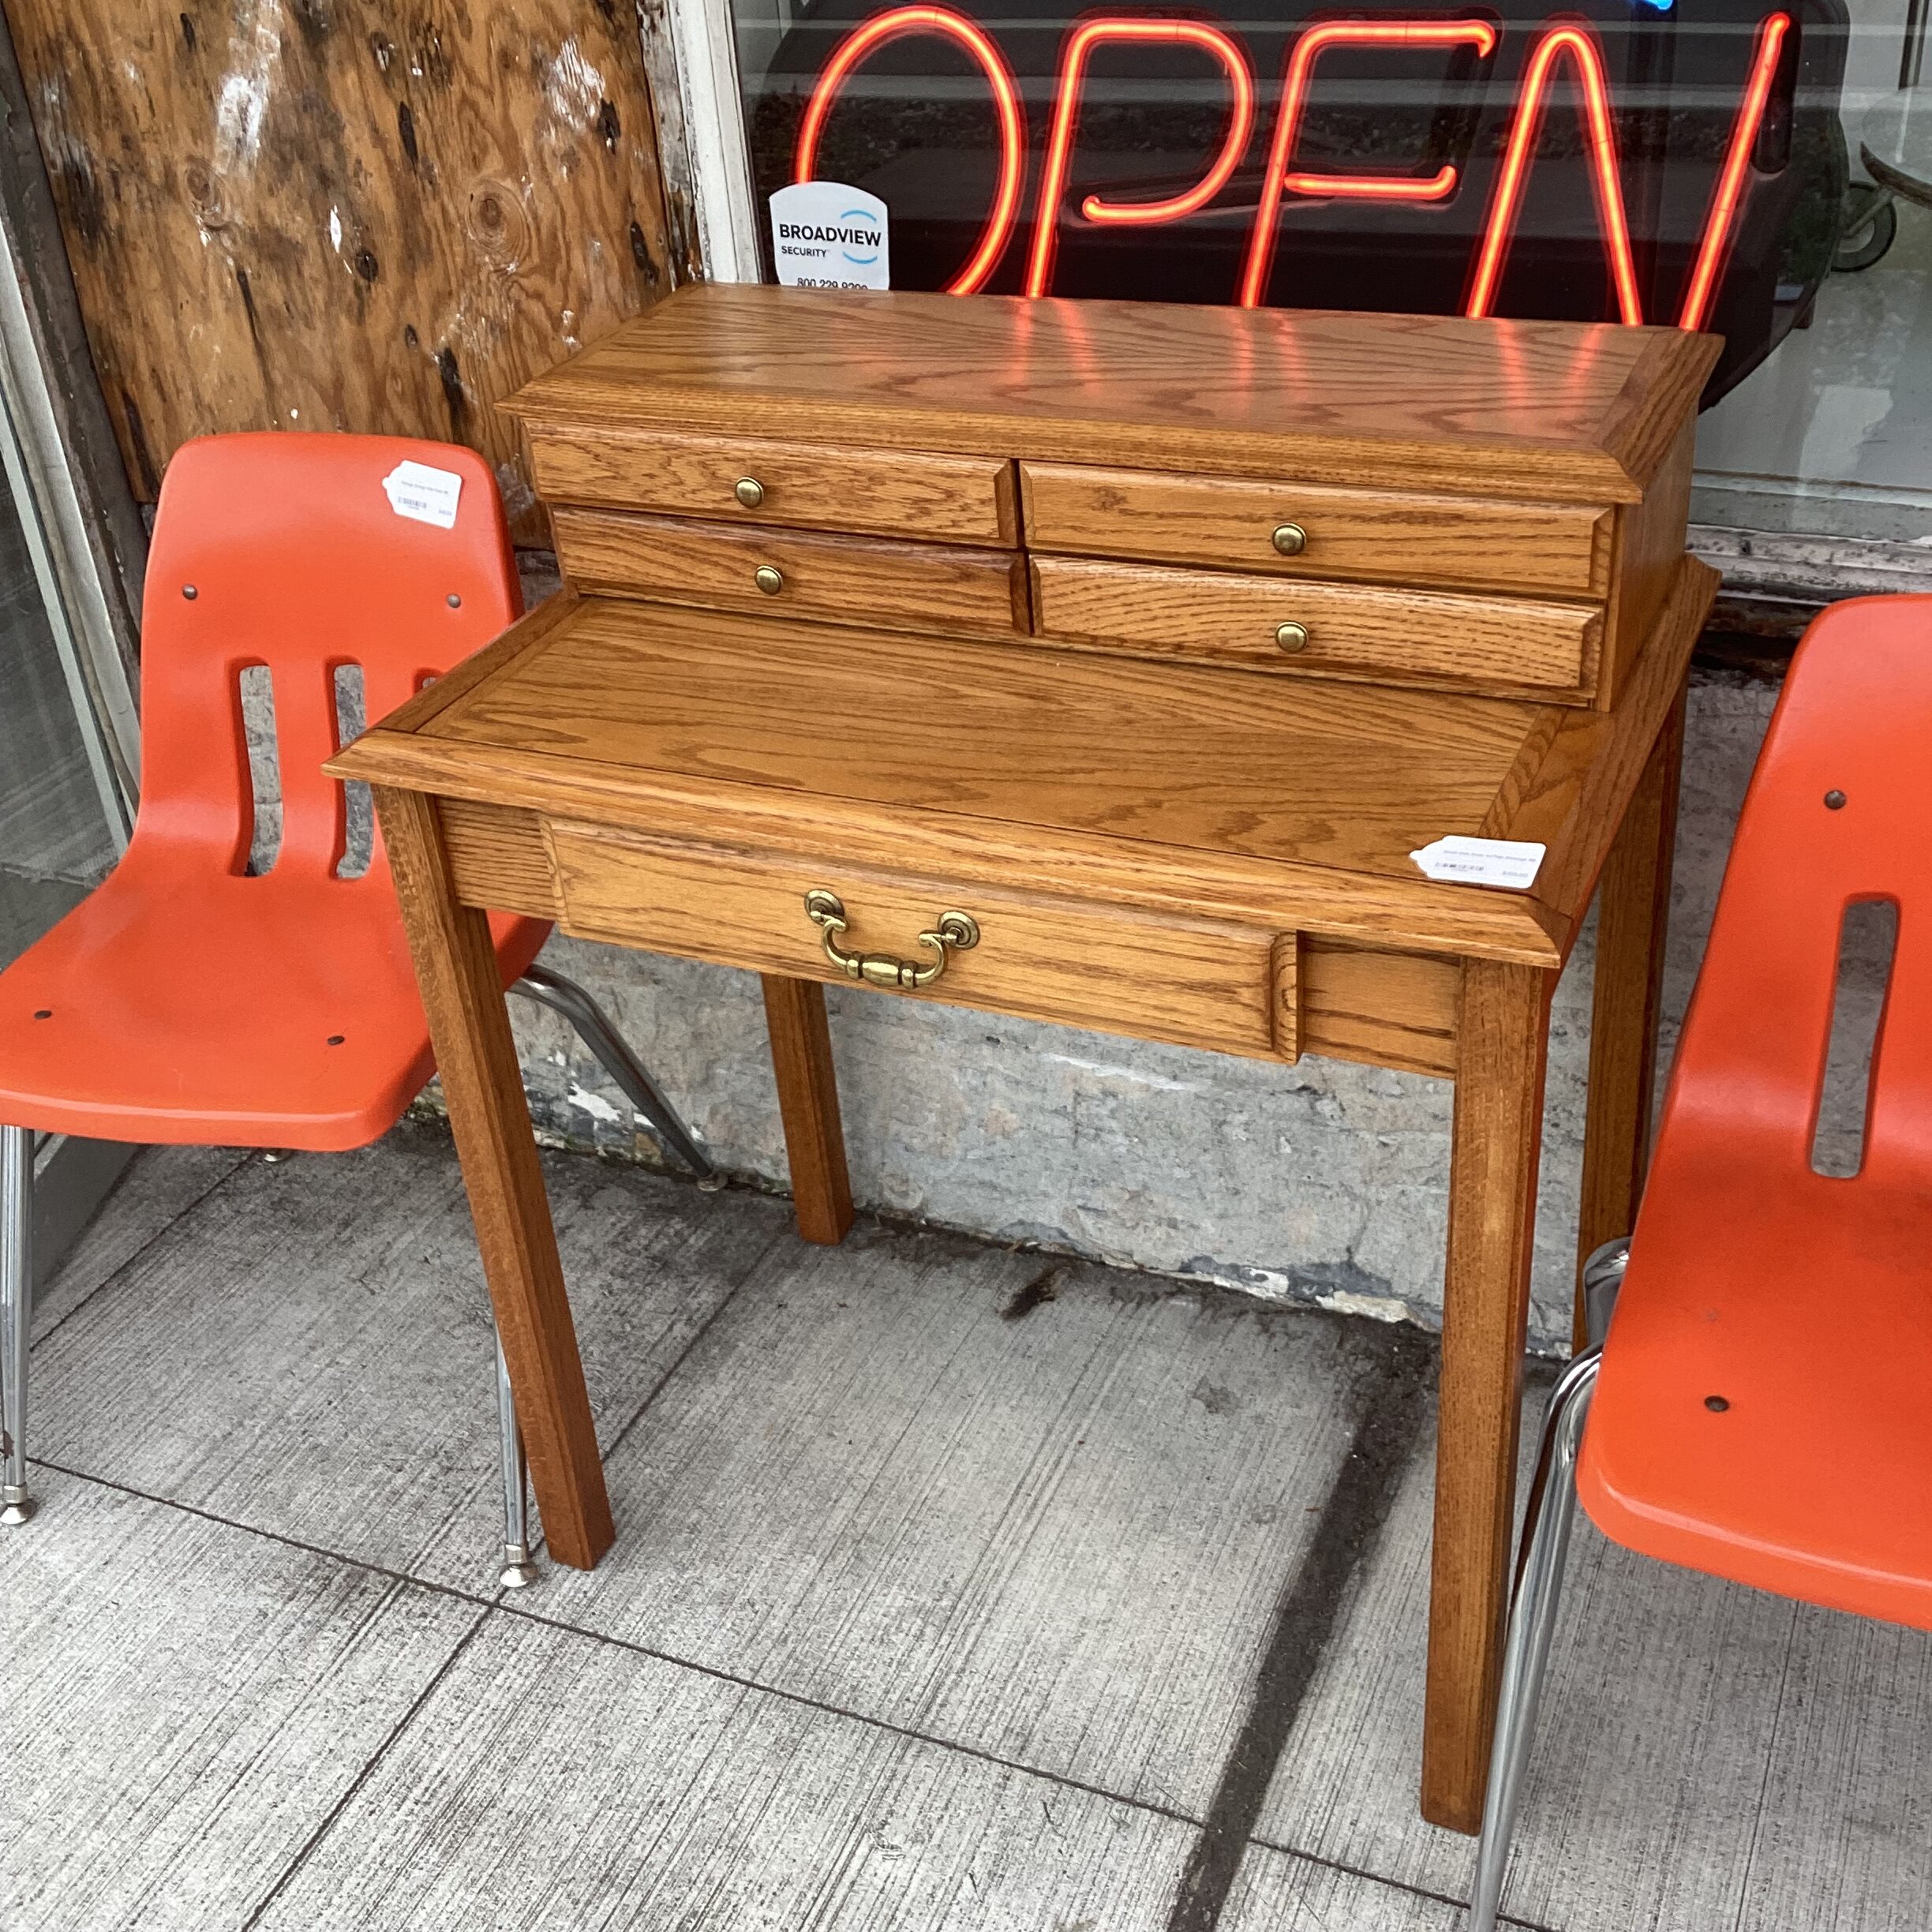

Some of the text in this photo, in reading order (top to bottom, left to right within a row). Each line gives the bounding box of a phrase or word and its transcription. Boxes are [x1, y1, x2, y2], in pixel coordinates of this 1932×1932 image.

[796, 5, 1791, 331] OPEN
[779, 223, 882, 247] BROADVIEW
[781, 245, 826, 257] SECURITY
